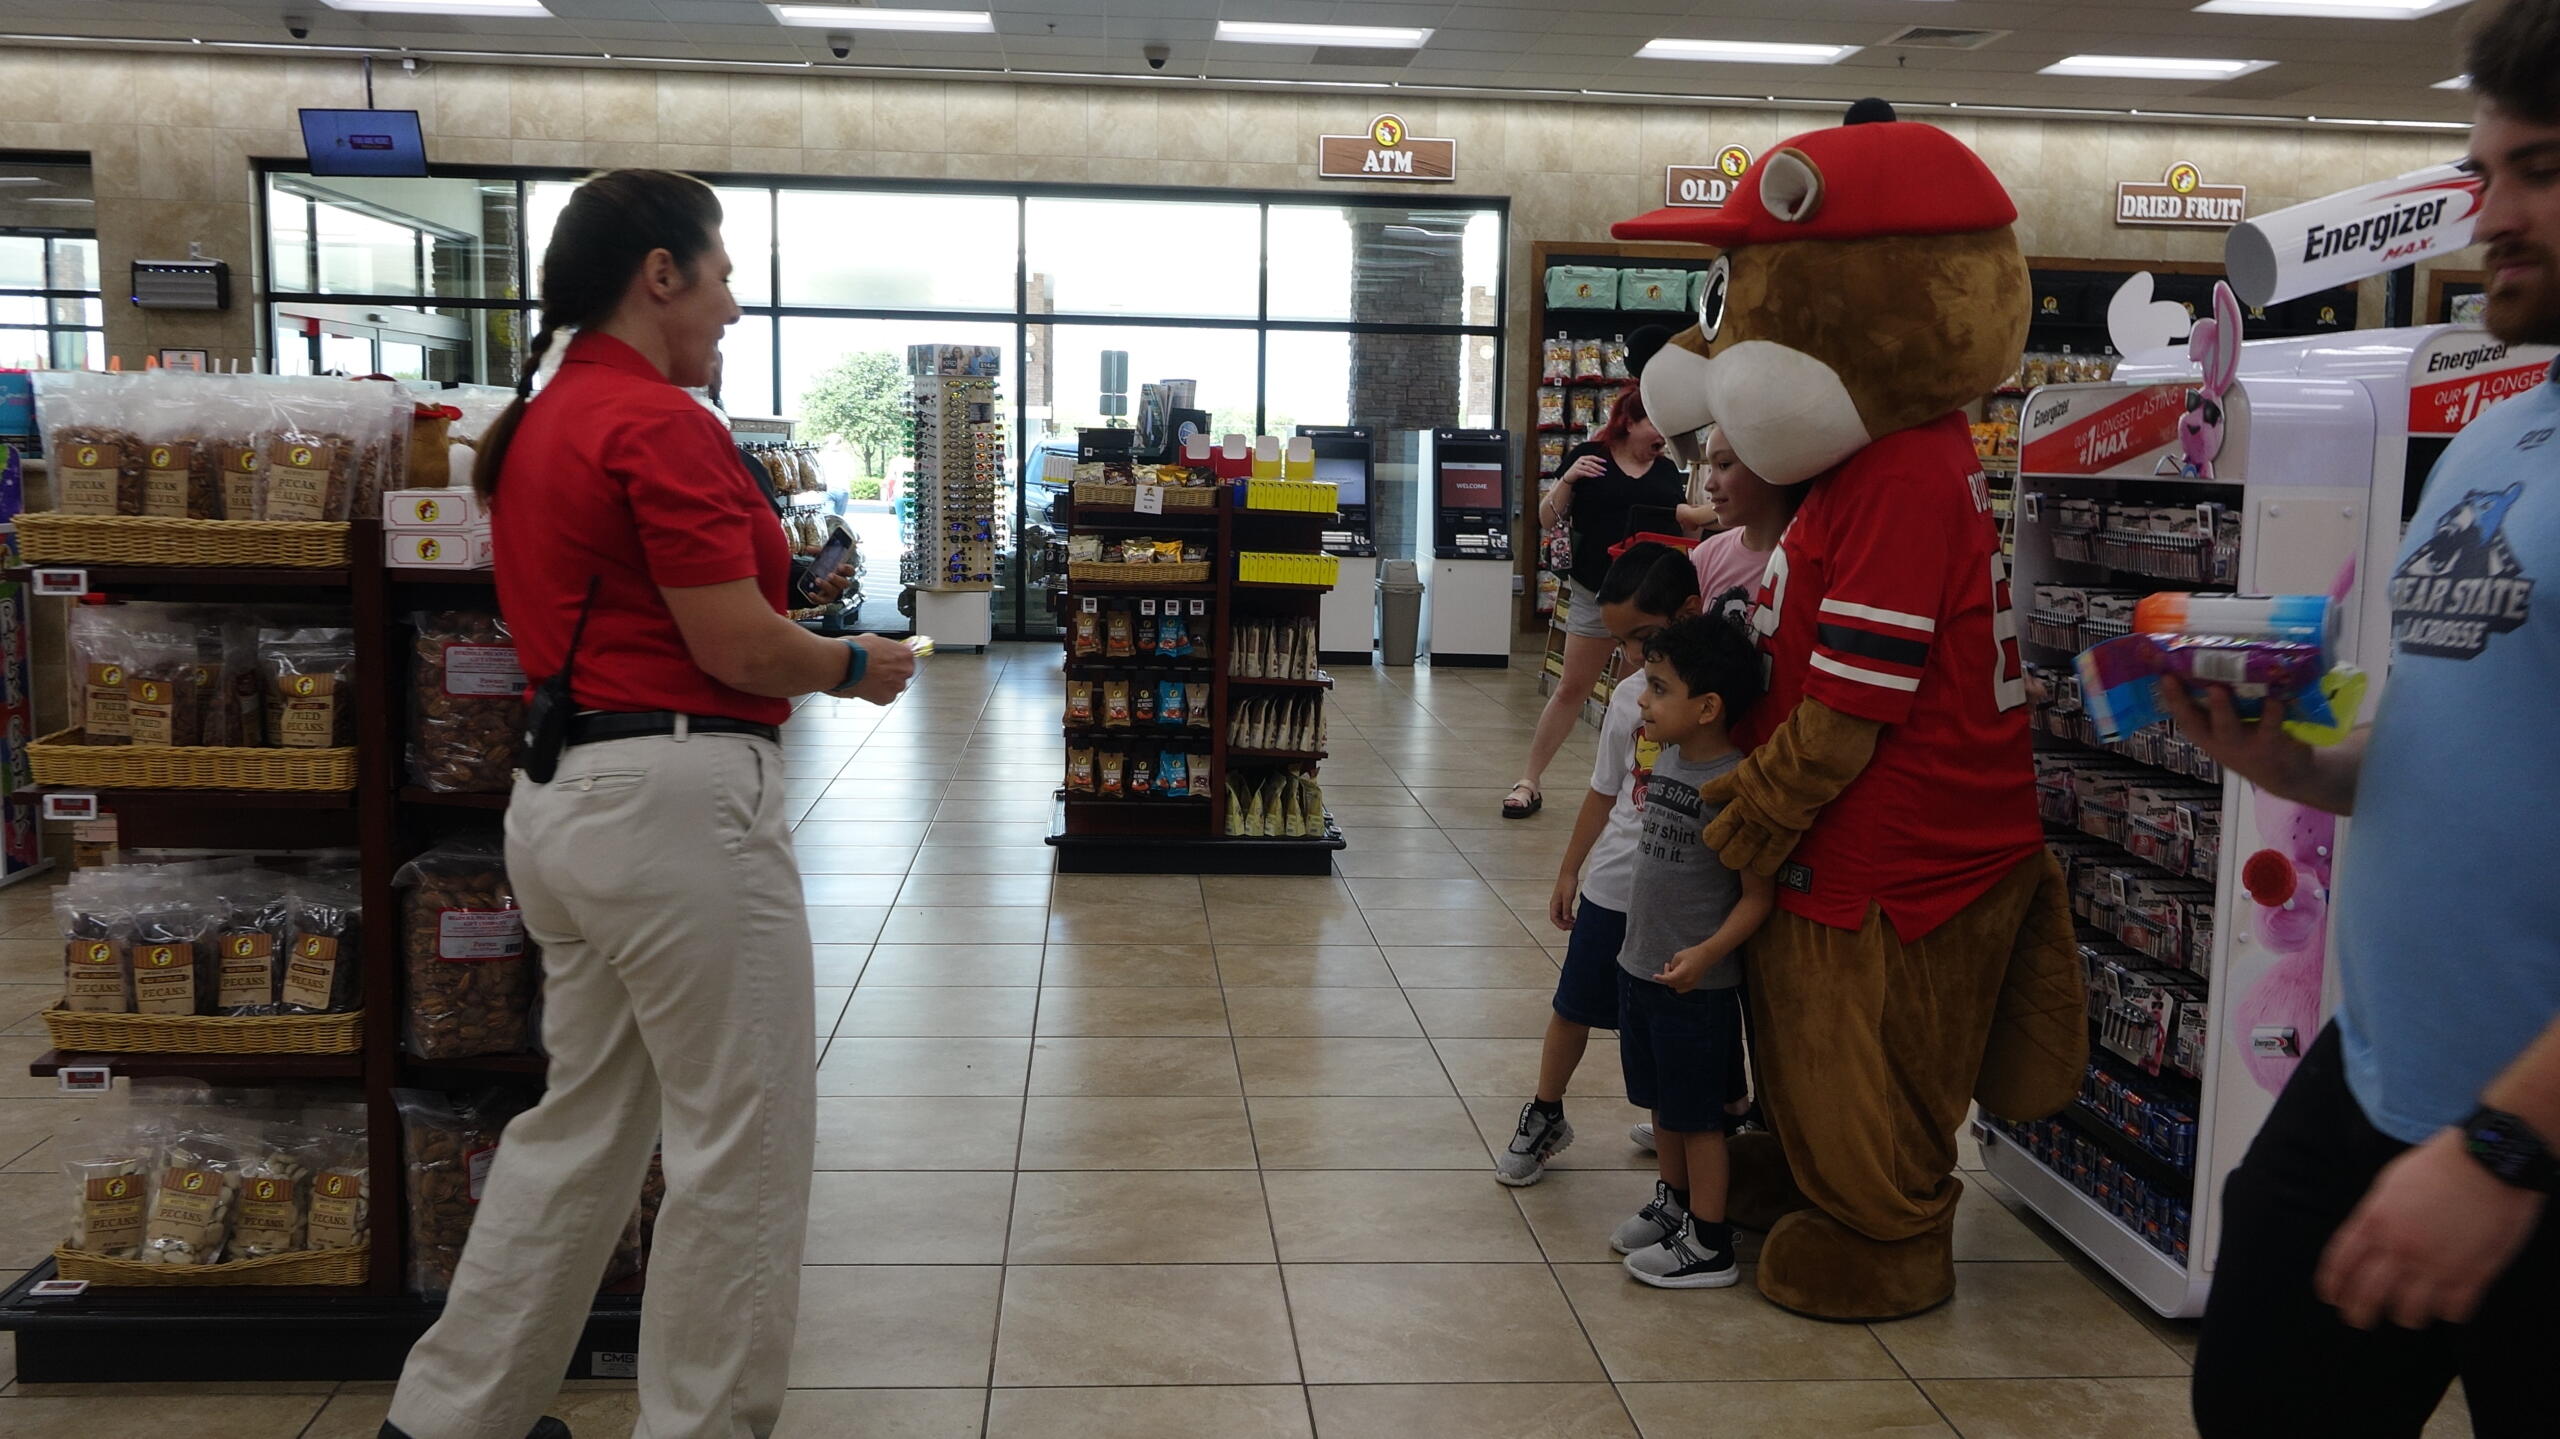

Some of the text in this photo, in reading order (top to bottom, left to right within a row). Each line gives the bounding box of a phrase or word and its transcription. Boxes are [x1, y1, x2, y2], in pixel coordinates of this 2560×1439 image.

[1362, 150, 1413, 173] ATM
[1680, 178, 1726, 201] OLD
[2122, 194, 2242, 220] DRIED FRUIT
[2303, 197, 2447, 263] Energizer
[2381, 237, 2433, 262] MAX
[2427, 344, 2509, 373] Energizer
[2481, 369, 2550, 396] LONGES
[2434, 388, 2462, 406] OUR
[2033, 399, 2070, 428] Energizer
[2095, 409, 2137, 438] LONGEST
[2135, 386, 2179, 420] LASTING
[2094, 428, 2130, 463] MAX
[278, 478, 317, 490] PECAN
[2446, 578, 2531, 619] STATE
[1661, 825, 1697, 845] shirt
[1653, 842, 1666, 859] in
[1670, 847, 1684, 863] it.
[75, 984, 121, 993] PECANS
[142, 987, 187, 998] PECANS
[223, 977, 265, 986] PECANS
[93, 1216, 138, 1229] PECANS
[160, 1209, 201, 1222] PECANS
[313, 1213, 347, 1225] PECANS
[602, 1353, 635, 1363] CMS
